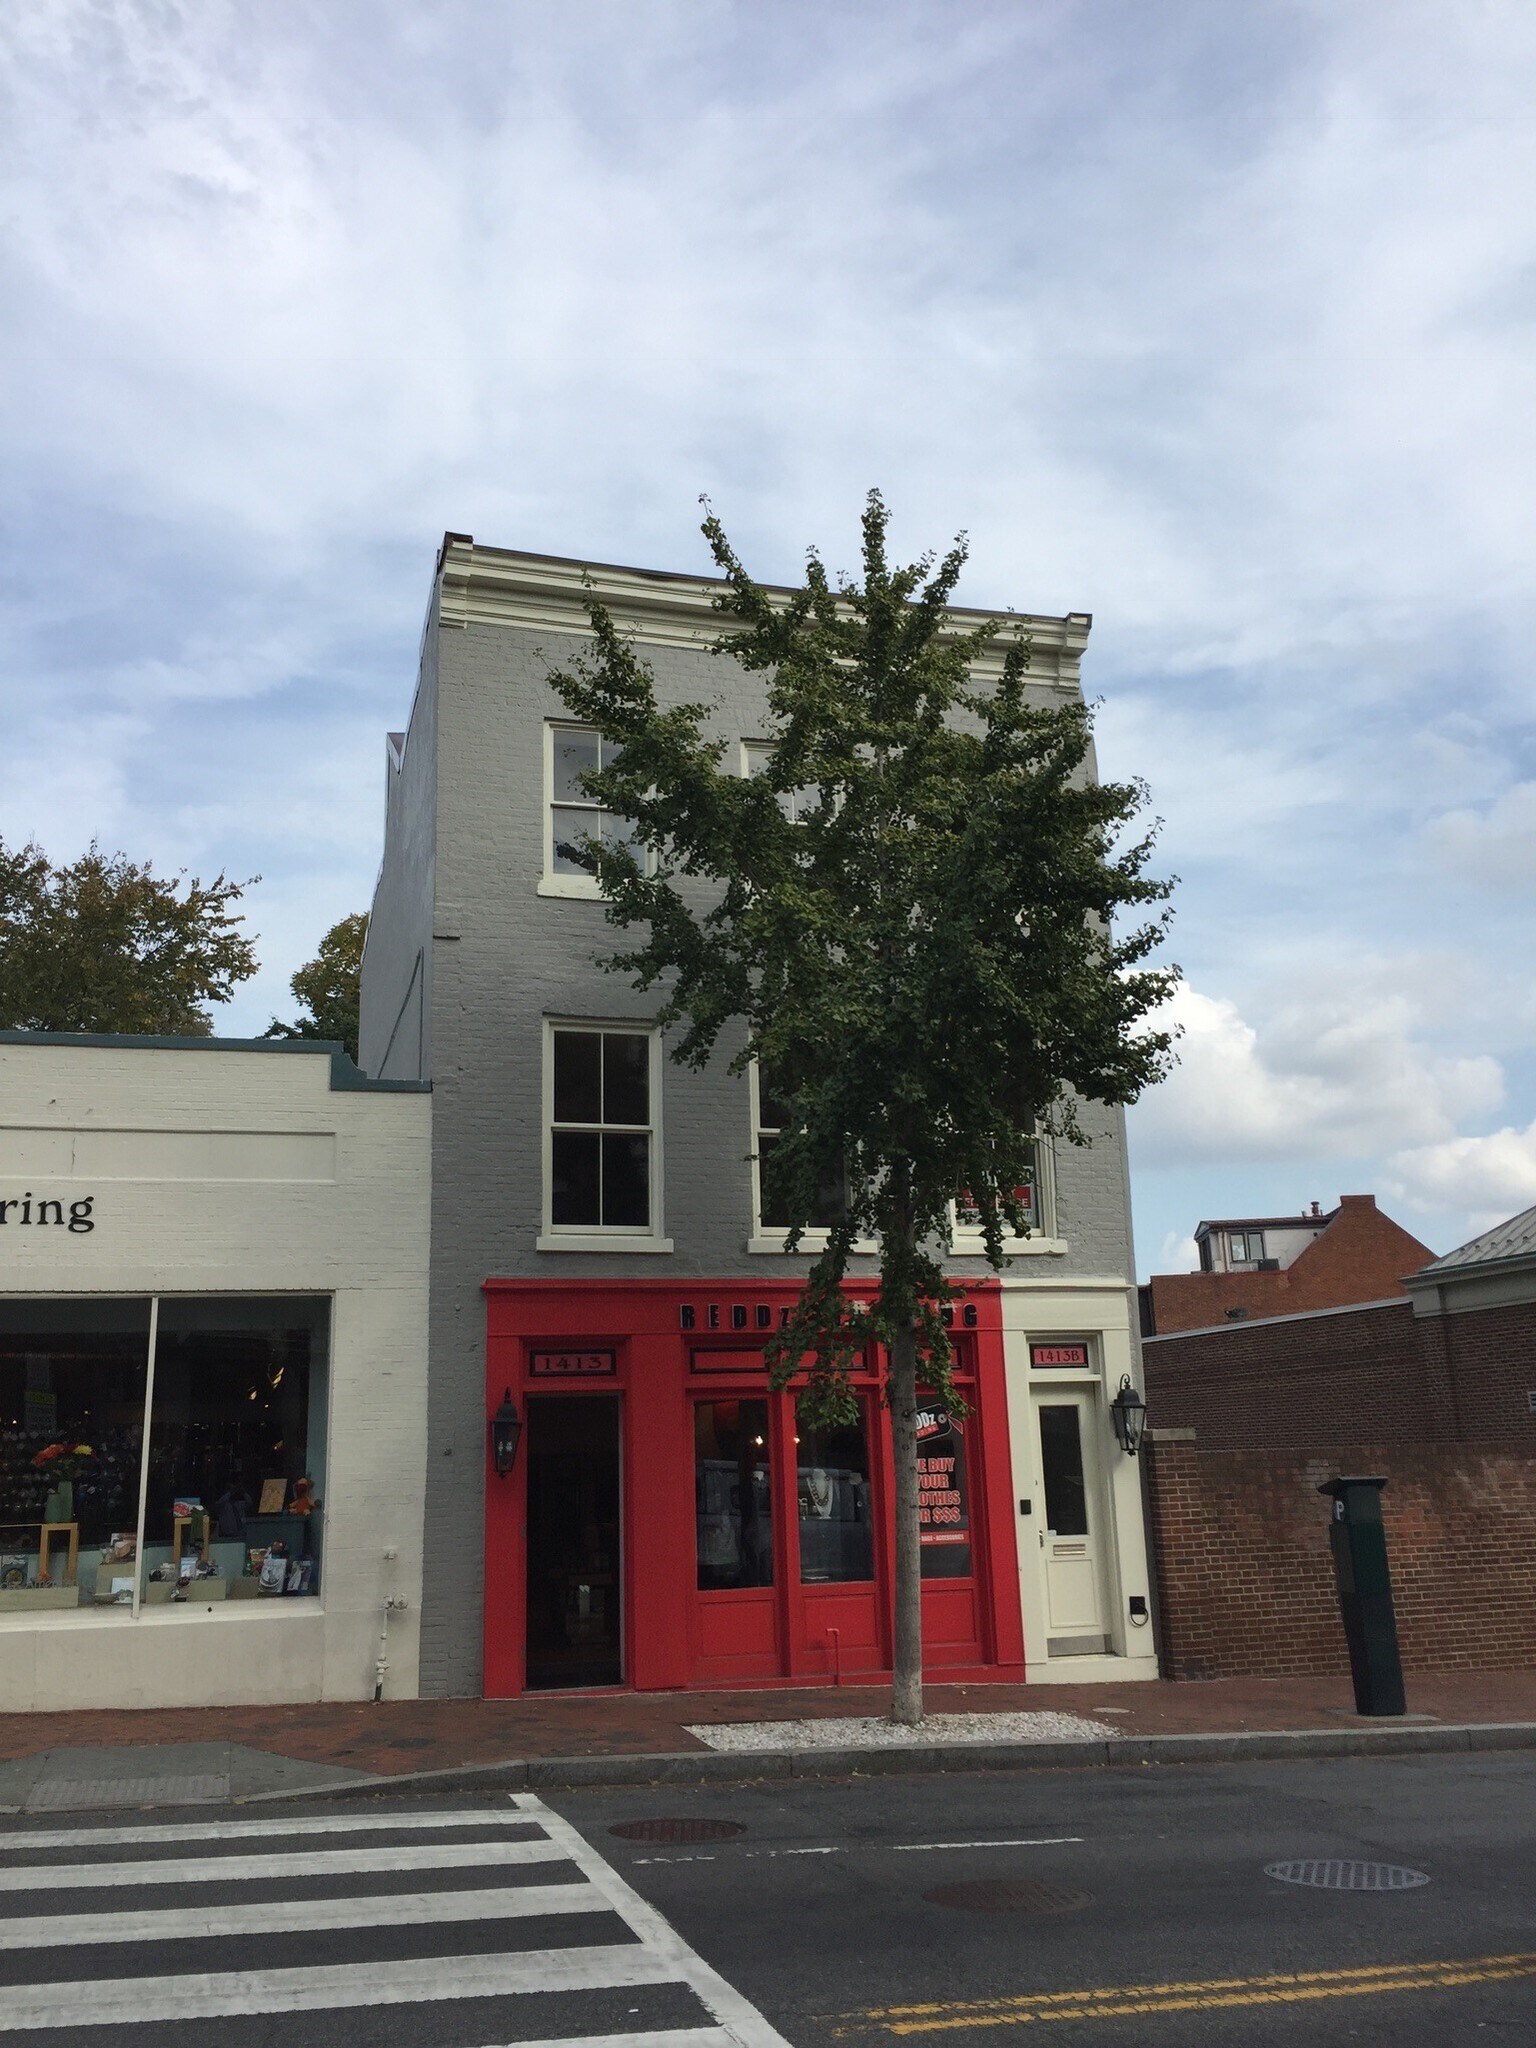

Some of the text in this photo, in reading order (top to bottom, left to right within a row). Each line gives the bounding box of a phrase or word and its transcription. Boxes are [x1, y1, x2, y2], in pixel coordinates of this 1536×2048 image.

[543, 1356, 602, 1370] 1413
[1038, 1350, 1080, 1362] 1413B
[928, 1458, 955, 1472] BUY
[918, 1490, 961, 1507] OTHES
[1335, 1500, 1345, 1521] P
